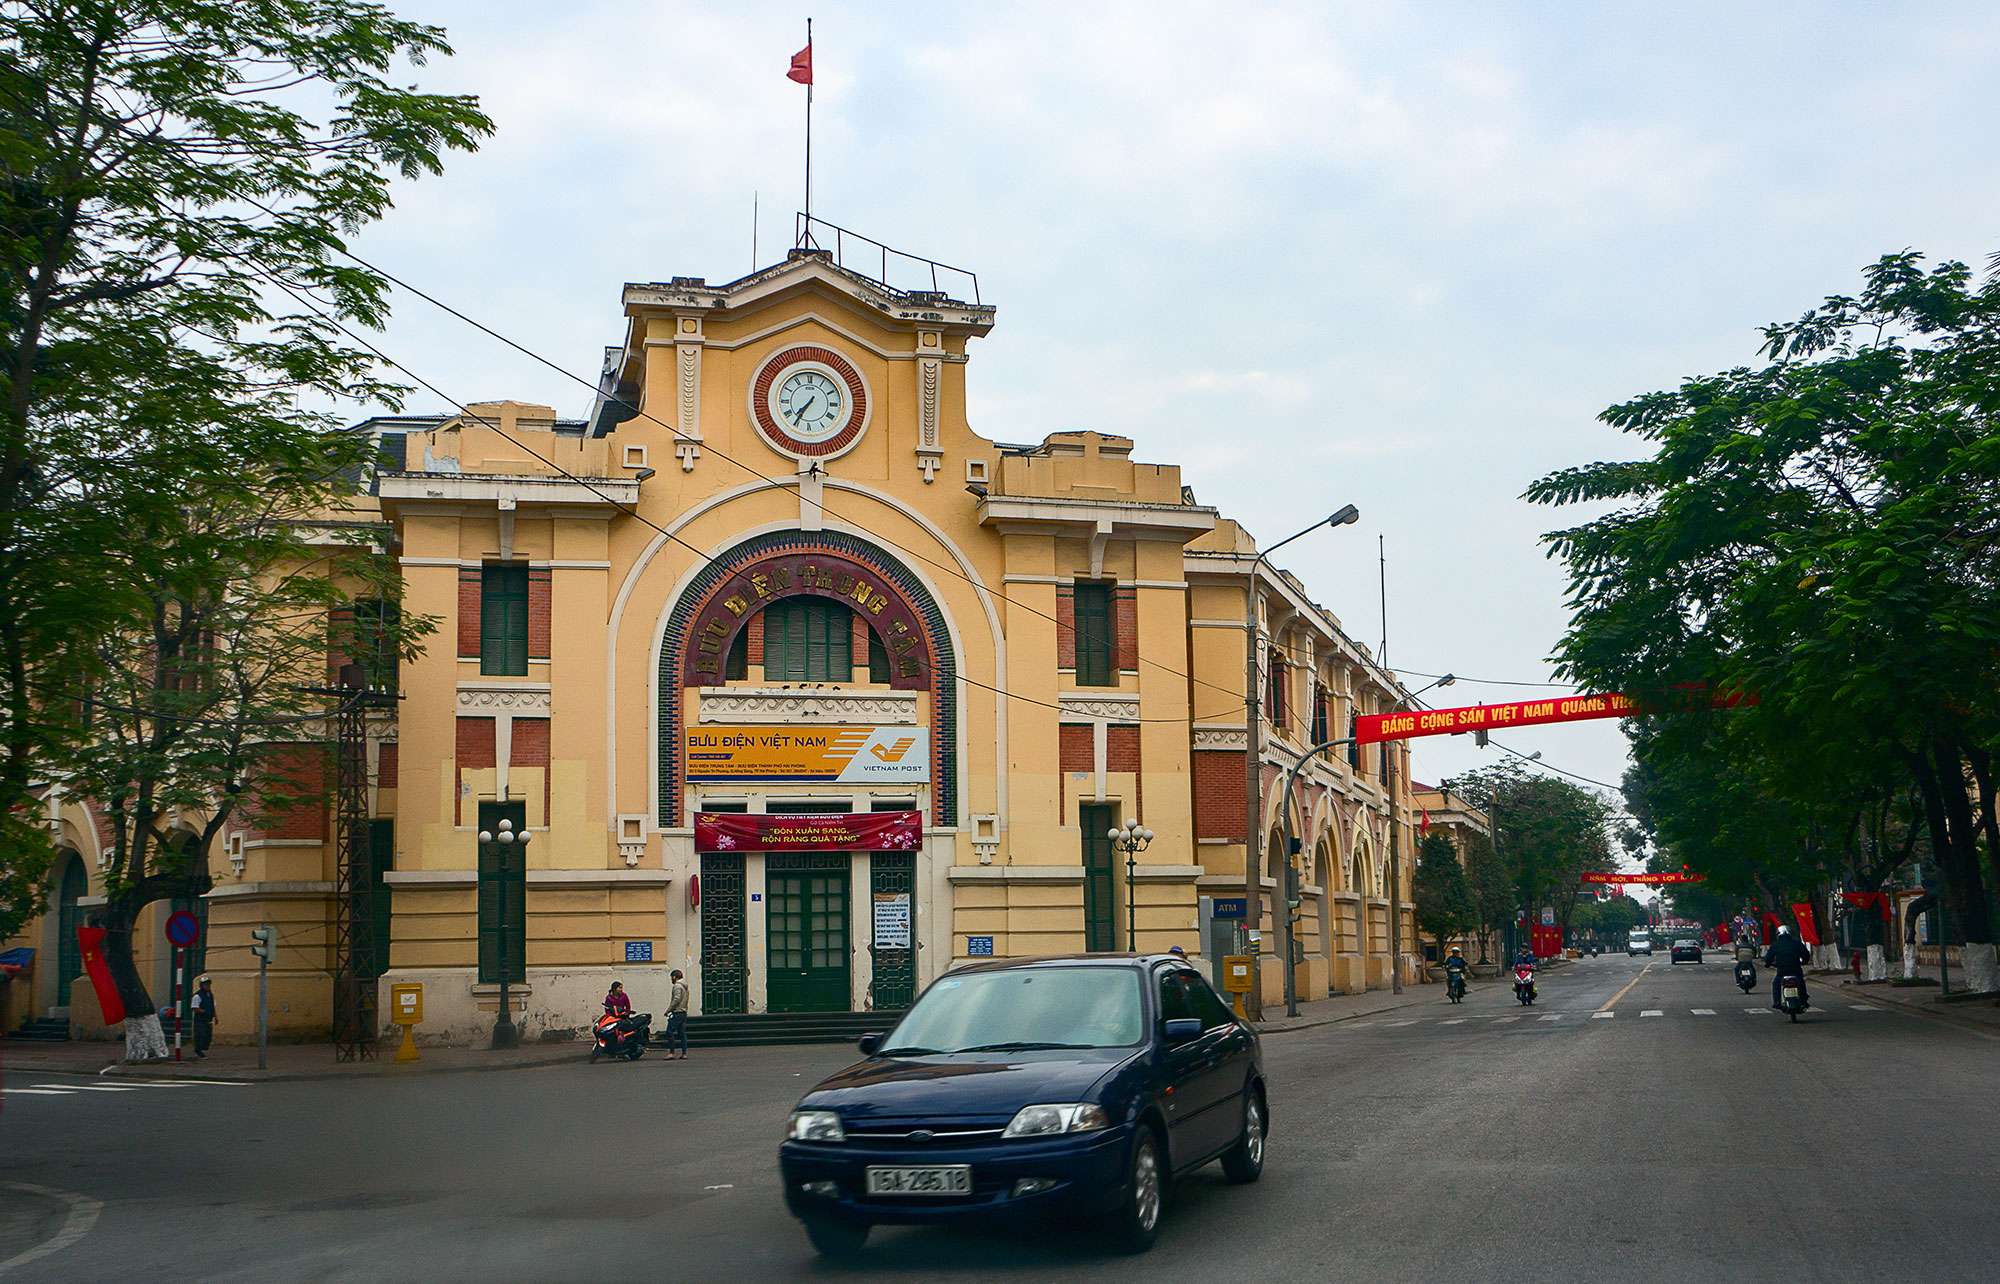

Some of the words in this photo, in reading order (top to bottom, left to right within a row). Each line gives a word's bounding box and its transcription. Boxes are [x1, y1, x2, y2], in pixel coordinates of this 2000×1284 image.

[797, 564, 888, 615] TRUNG
[1420, 712, 1454, 731] CỘNG
[1491, 703, 1518, 723] VIỆT
[1523, 702, 1554, 718] NAM
[1561, 697, 1606, 715] QUANG
[688, 734, 717, 747] BƯU
[722, 733, 755, 750] ĐIỆN
[760, 733, 791, 750] VIỆT
[795, 736, 826, 747] NAM
[1218, 903, 1237, 912] ATM
